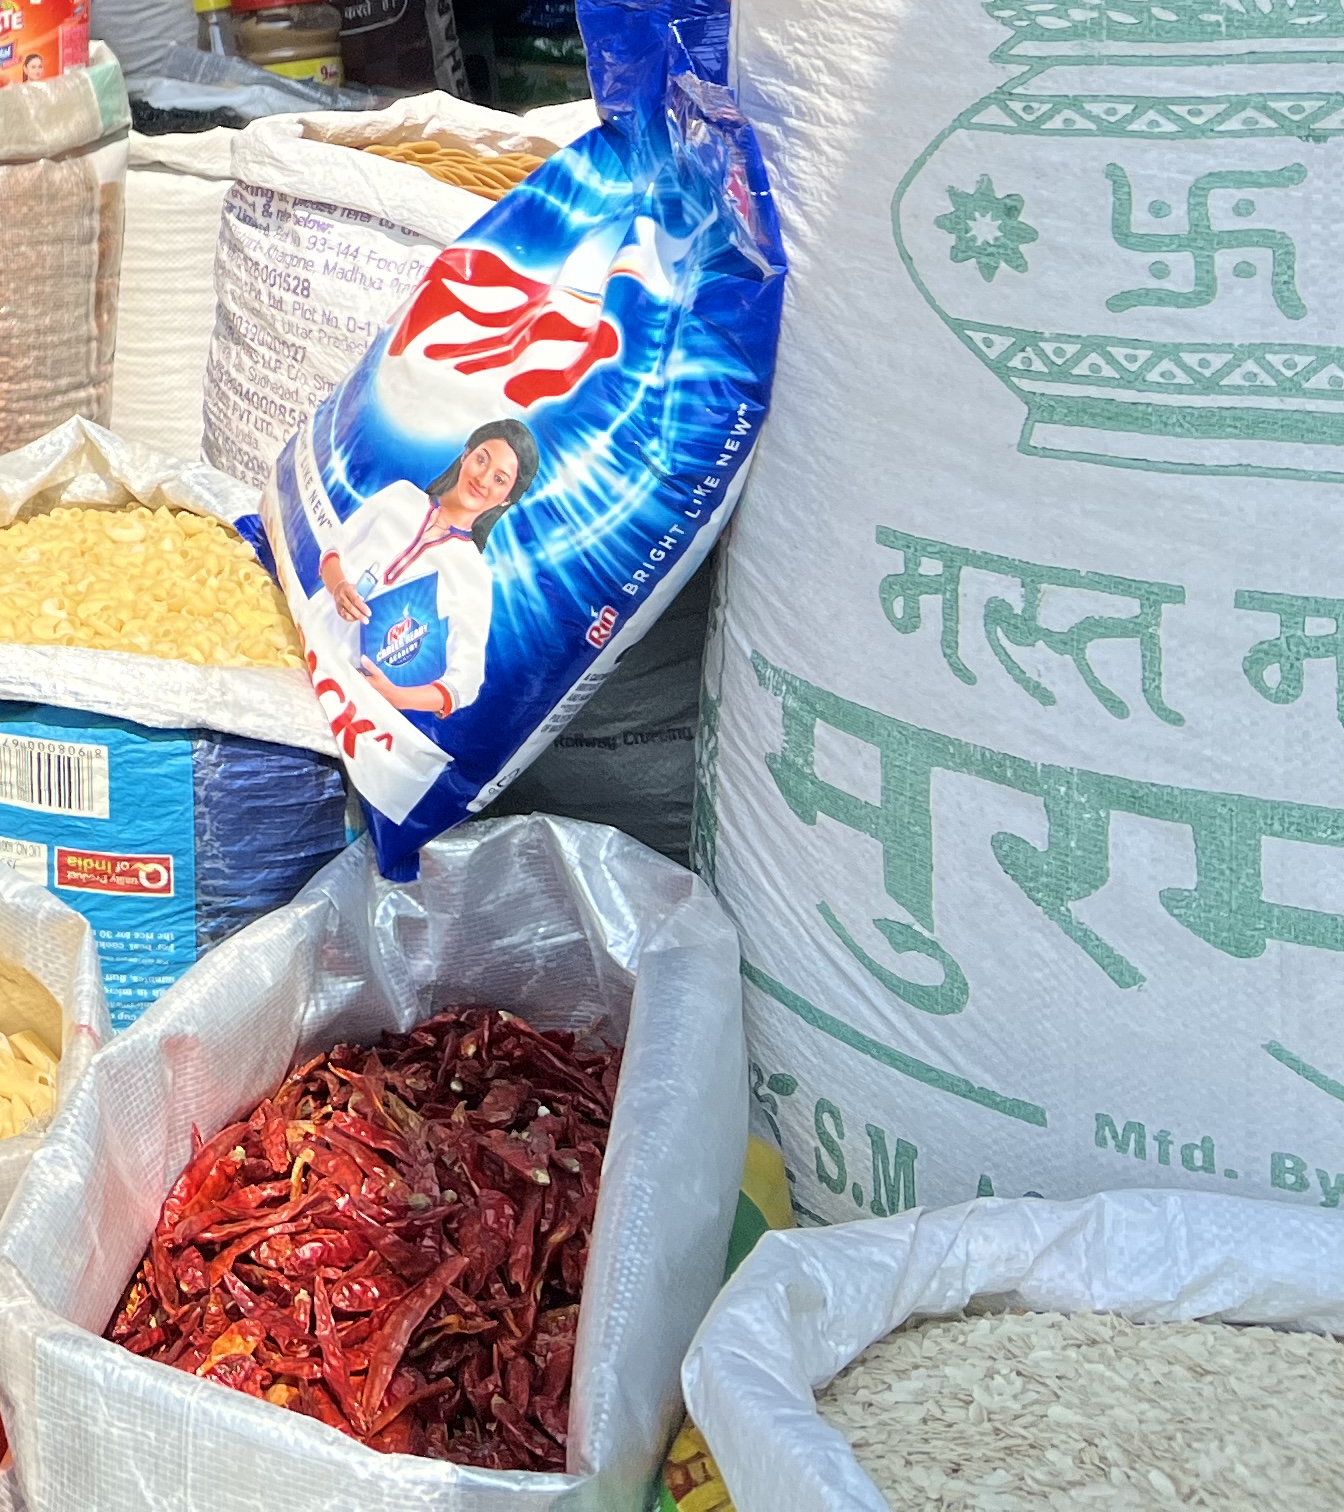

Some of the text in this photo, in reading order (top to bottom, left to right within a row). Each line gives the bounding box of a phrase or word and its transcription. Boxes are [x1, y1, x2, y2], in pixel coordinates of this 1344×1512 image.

[586, 605, 618, 648] Rin
[622, 523, 685, 596] BRIGHT
[684, 475, 721, 519] LIKE
[875, 524, 1186, 727] मस्त
[66, 854, 131, 874] of India
[1094, 1112, 1239, 1180] Mfd.
